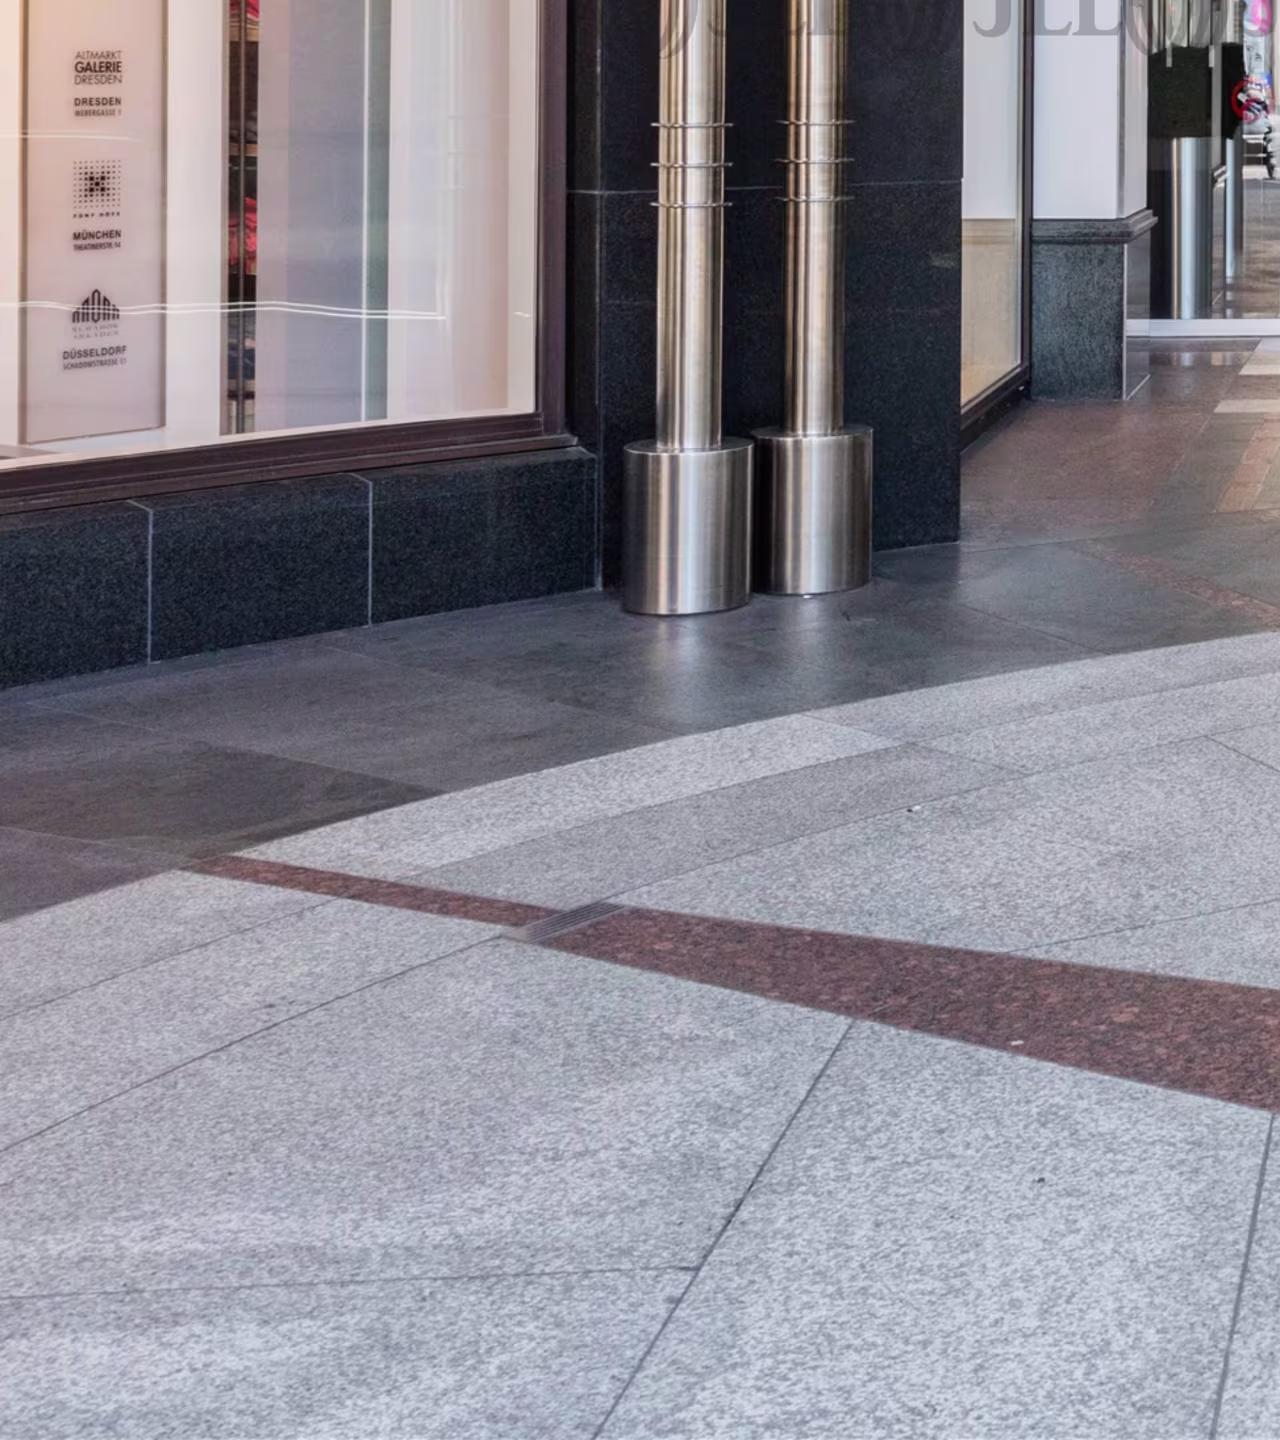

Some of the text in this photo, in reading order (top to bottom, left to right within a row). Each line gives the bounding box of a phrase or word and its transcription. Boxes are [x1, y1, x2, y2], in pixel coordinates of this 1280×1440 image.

[74, 60, 122, 73] GALERIE
[74, 74, 123, 85] DRESDEN
[74, 97, 122, 106] DRESDEN
[73, 229, 122, 241] MÜNCHEN
[62, 345, 127, 360] DÜSSELDORF
